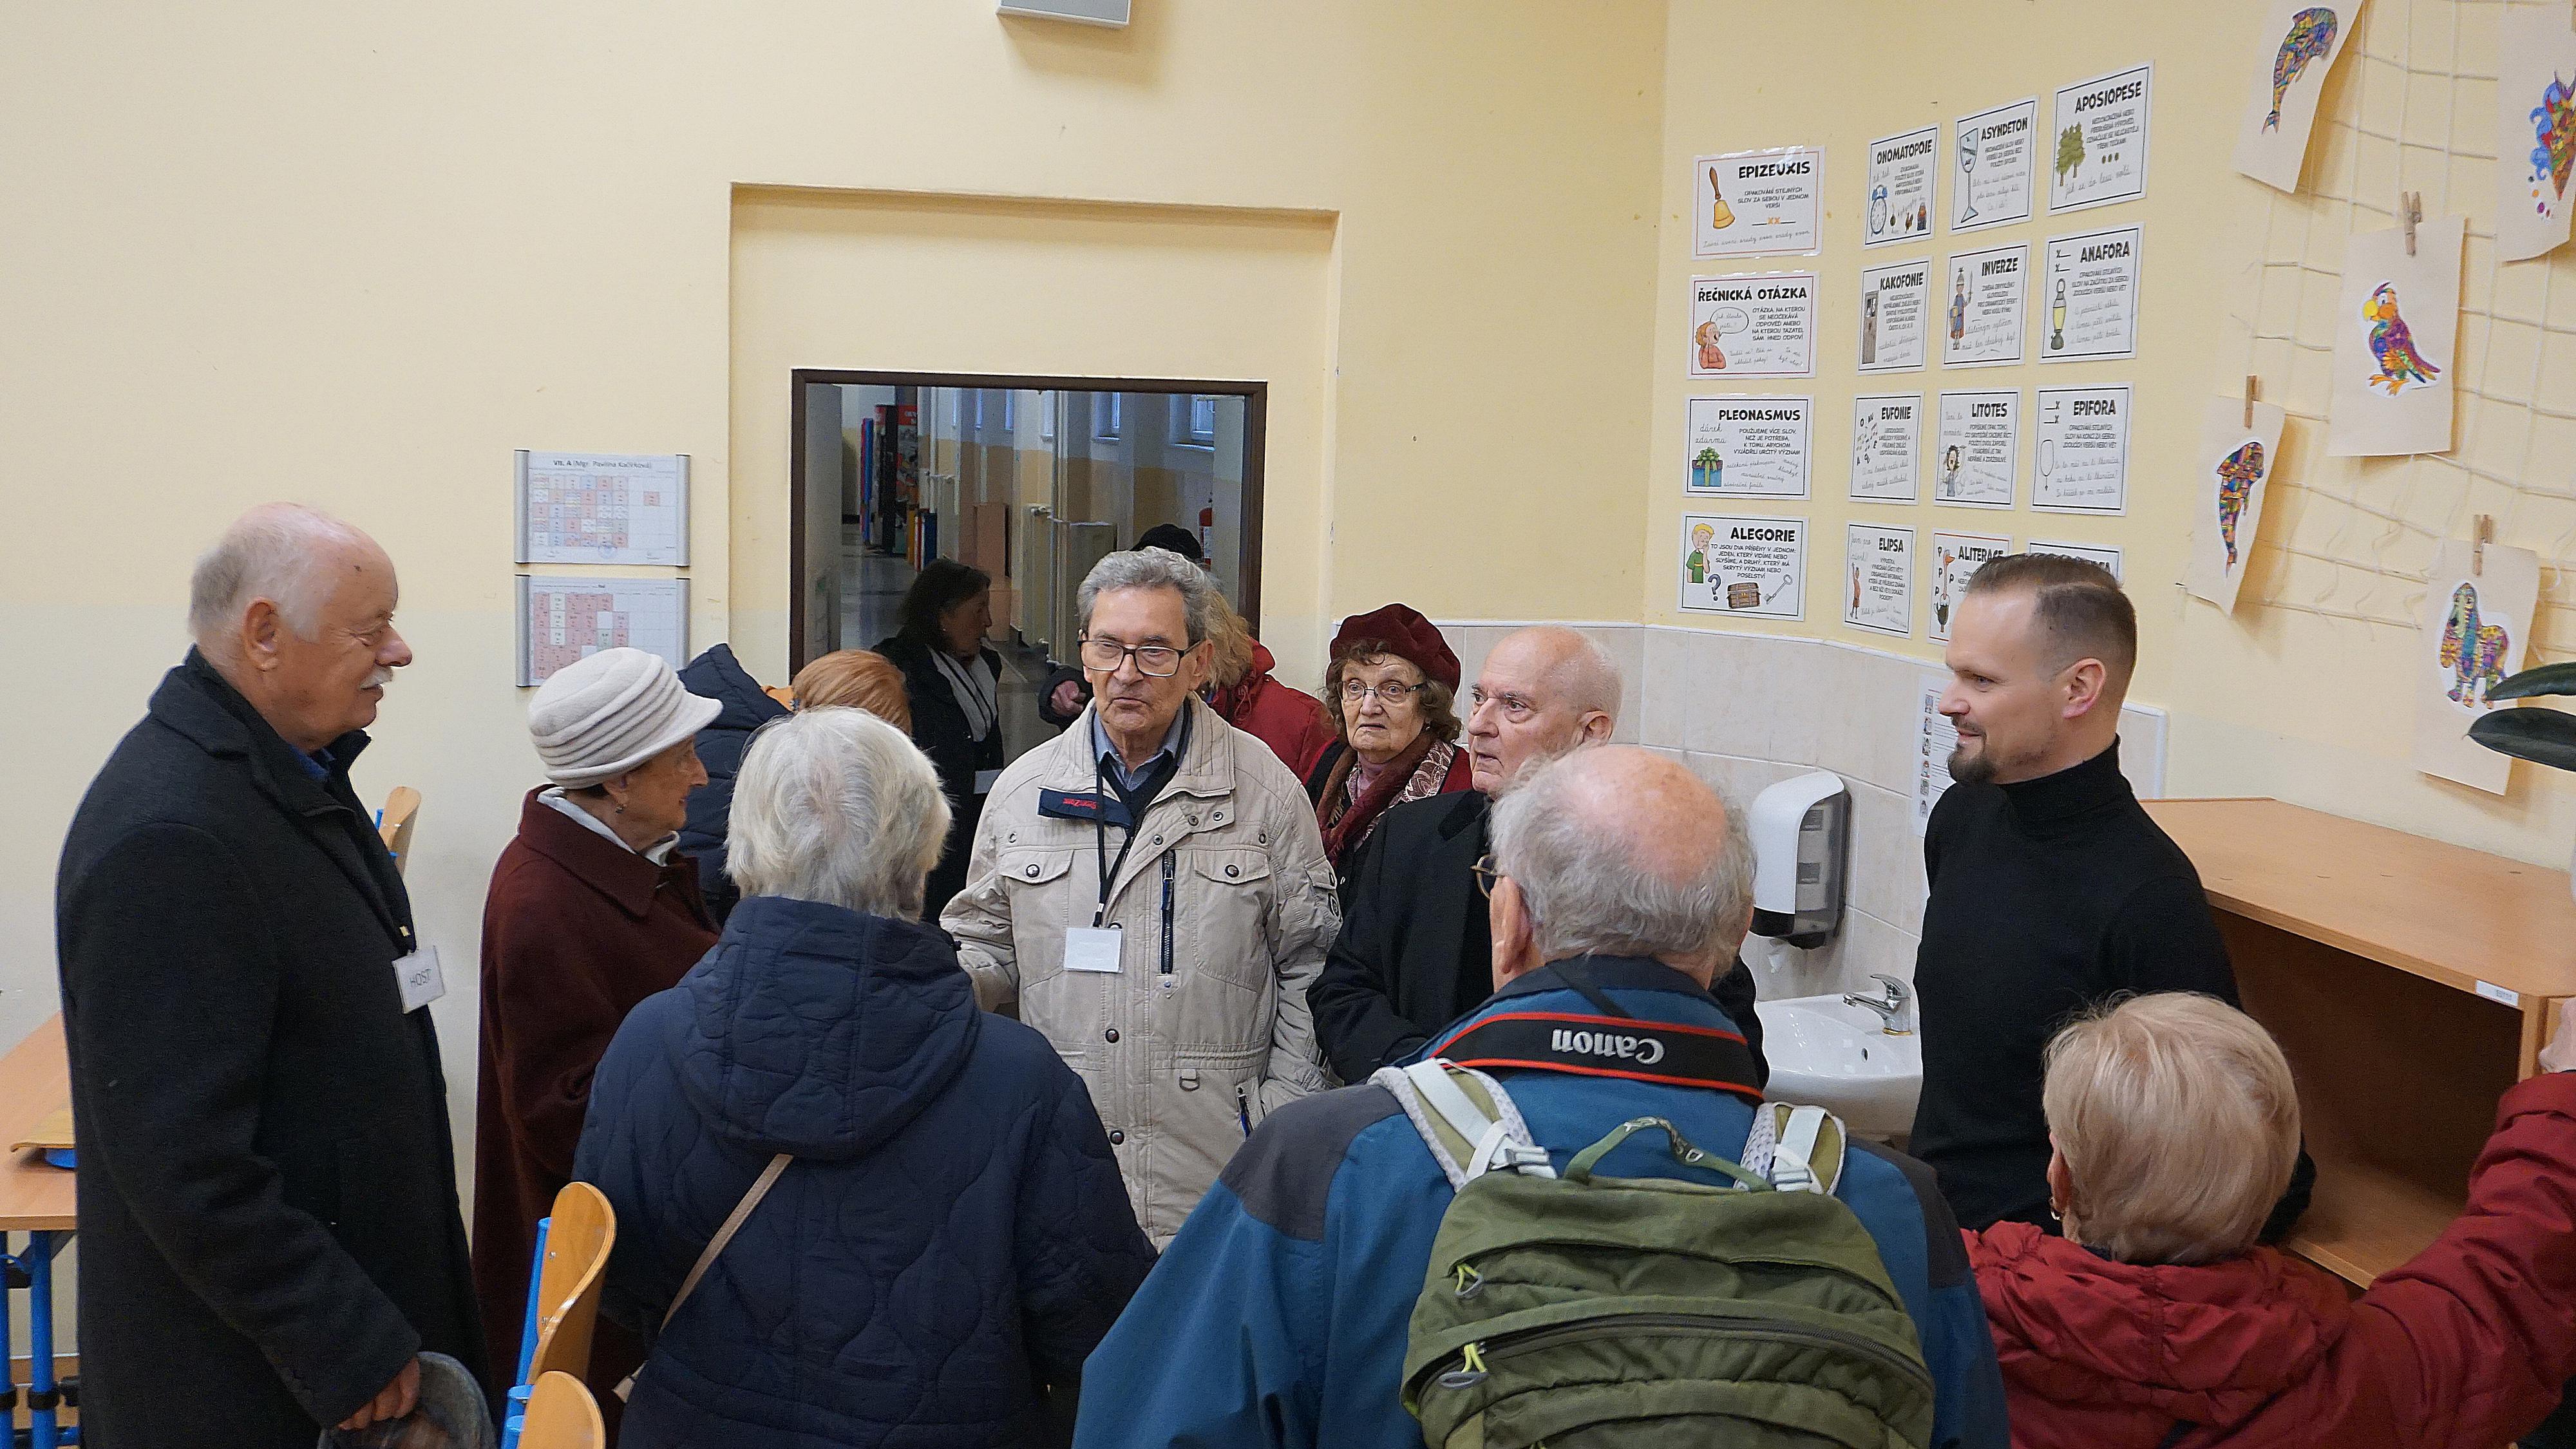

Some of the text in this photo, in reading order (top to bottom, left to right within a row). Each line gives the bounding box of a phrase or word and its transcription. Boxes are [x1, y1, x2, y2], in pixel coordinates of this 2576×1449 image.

[2075, 81, 2142, 113] APOSIOPESE
[1981, 117, 2028, 141] ASYNDETON
[1877, 139, 1932, 164] ONOMATOPOIE
[1739, 162, 1810, 179] EPIZEUXIS
[2080, 241, 2130, 263] ANAFORA
[1982, 258, 2018, 276] INVERZE
[1880, 272, 1924, 290] KAKOFONIE
[1698, 285, 1807, 301] ŘEČNICKÁ OTÁZKA
[1719, 410, 1800, 421] PLEONASMUS
[1882, 406, 1911, 420] EUFONIE
[1972, 402, 2007, 417] LITOTES
[2074, 400, 2116, 415] EPIFORA
[1700, 423, 1722, 432] dárek
[1730, 527, 1795, 542] ALEGORIE
[1879, 538, 1904, 553] ELIPSA
[410, 969, 433, 987] HOST
[1552, 1029, 1665, 1065] Canon
